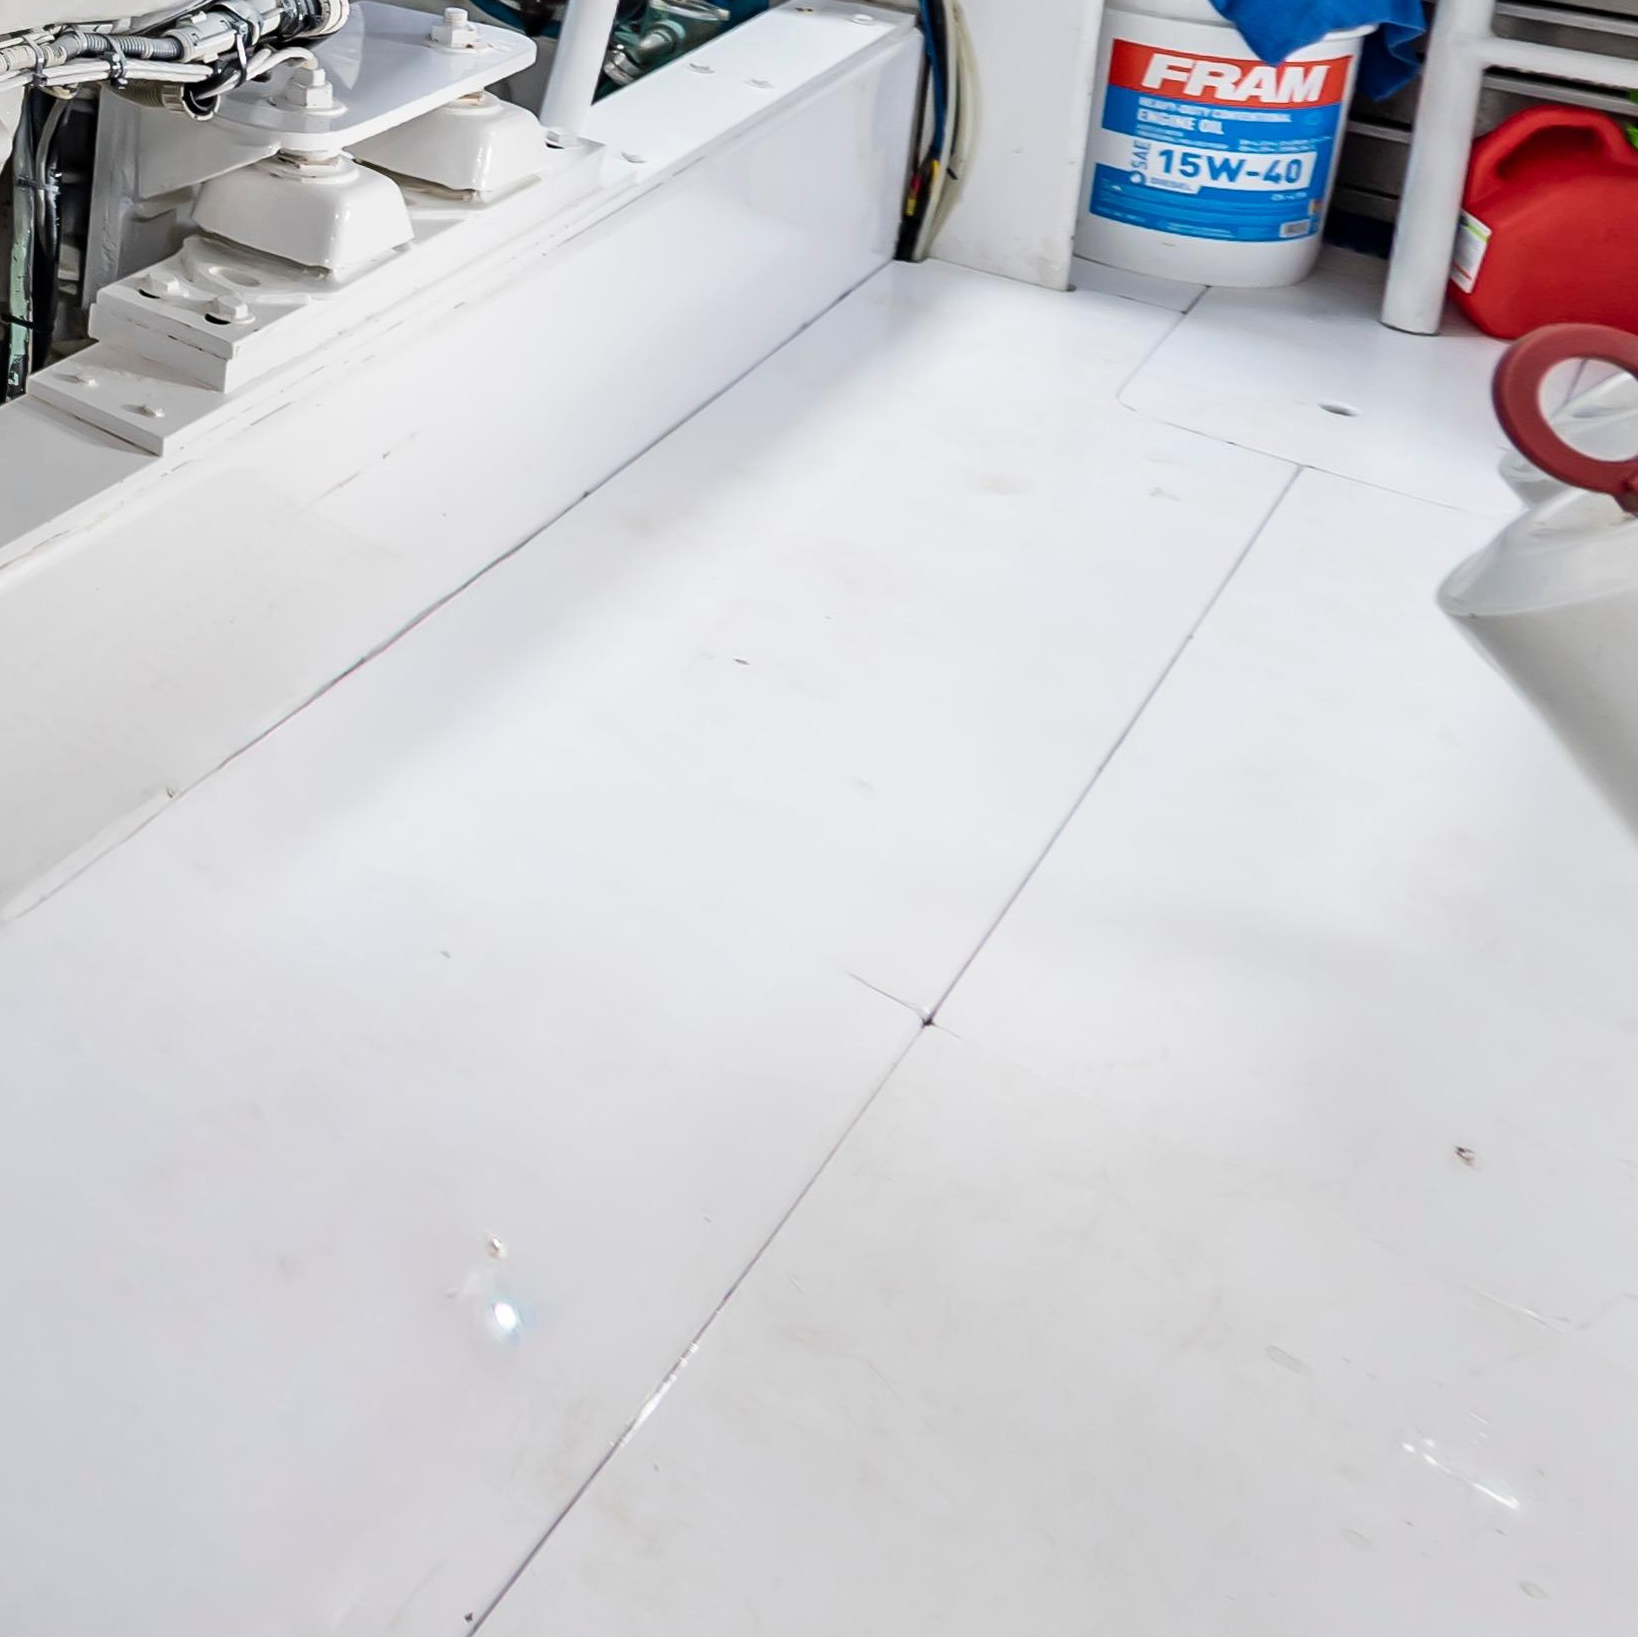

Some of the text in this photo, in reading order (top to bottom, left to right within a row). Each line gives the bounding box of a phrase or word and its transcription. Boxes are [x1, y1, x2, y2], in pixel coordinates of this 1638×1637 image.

[1141, 53, 1331, 103] FRAM
[1132, 140, 1151, 170] SAE
[1158, 149, 1303, 185] 15W-40
